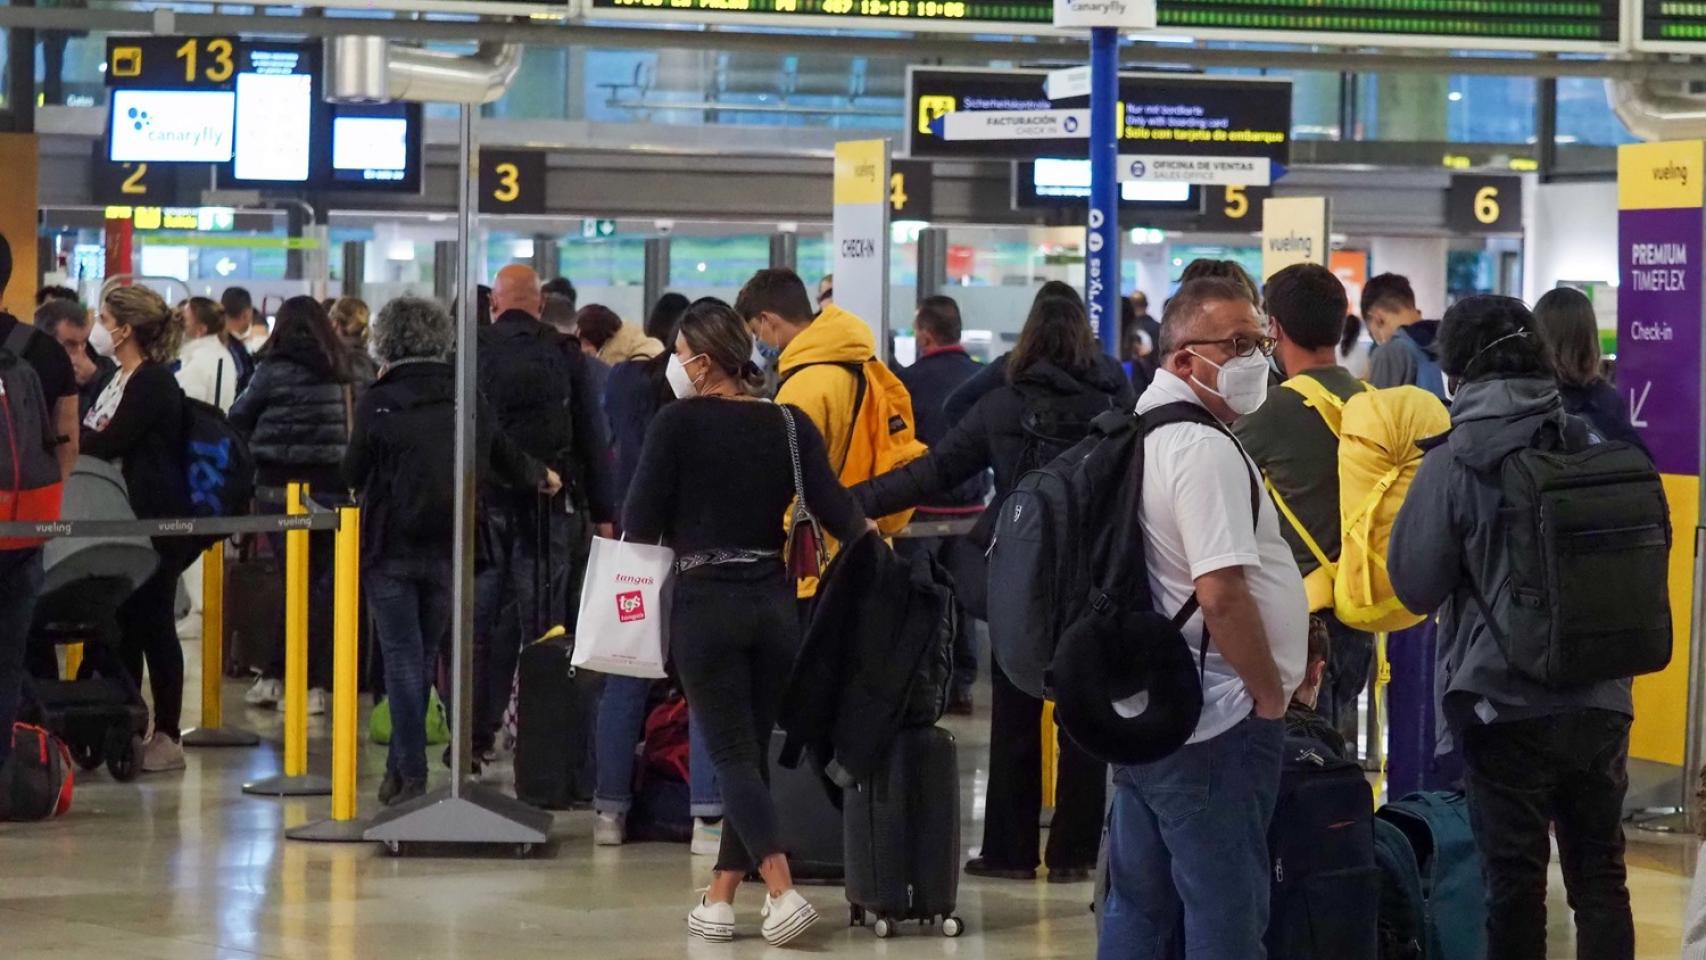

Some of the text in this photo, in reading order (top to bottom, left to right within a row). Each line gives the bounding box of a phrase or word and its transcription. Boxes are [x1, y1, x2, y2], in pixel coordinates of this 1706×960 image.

[1071, 0, 1127, 15] canaryfly
[176, 37, 234, 83] 13
[986, 115, 1057, 126] FACTURACIÓN
[148, 127, 224, 147] canaryfly
[1152, 160, 1255, 171] OFICINA DE VENTAS
[1152, 171, 1183, 180] SALES
[1652, 160, 1688, 186] vueling
[121, 163, 147, 194] 2
[493, 162, 520, 202] 3
[890, 172, 908, 210] 4
[1224, 184, 1249, 219] 5
[1474, 186, 1500, 224] 6
[1269, 229, 1312, 258] vueling
[1631, 243, 1687, 266] PREMIUM
[1631, 269, 1686, 292] TIMEFLEX
[1630, 321, 1673, 341] Check-in
[35, 521, 72, 535] vueling
[158, 520, 194, 534] vueling
[277, 516, 313, 528] vueling
